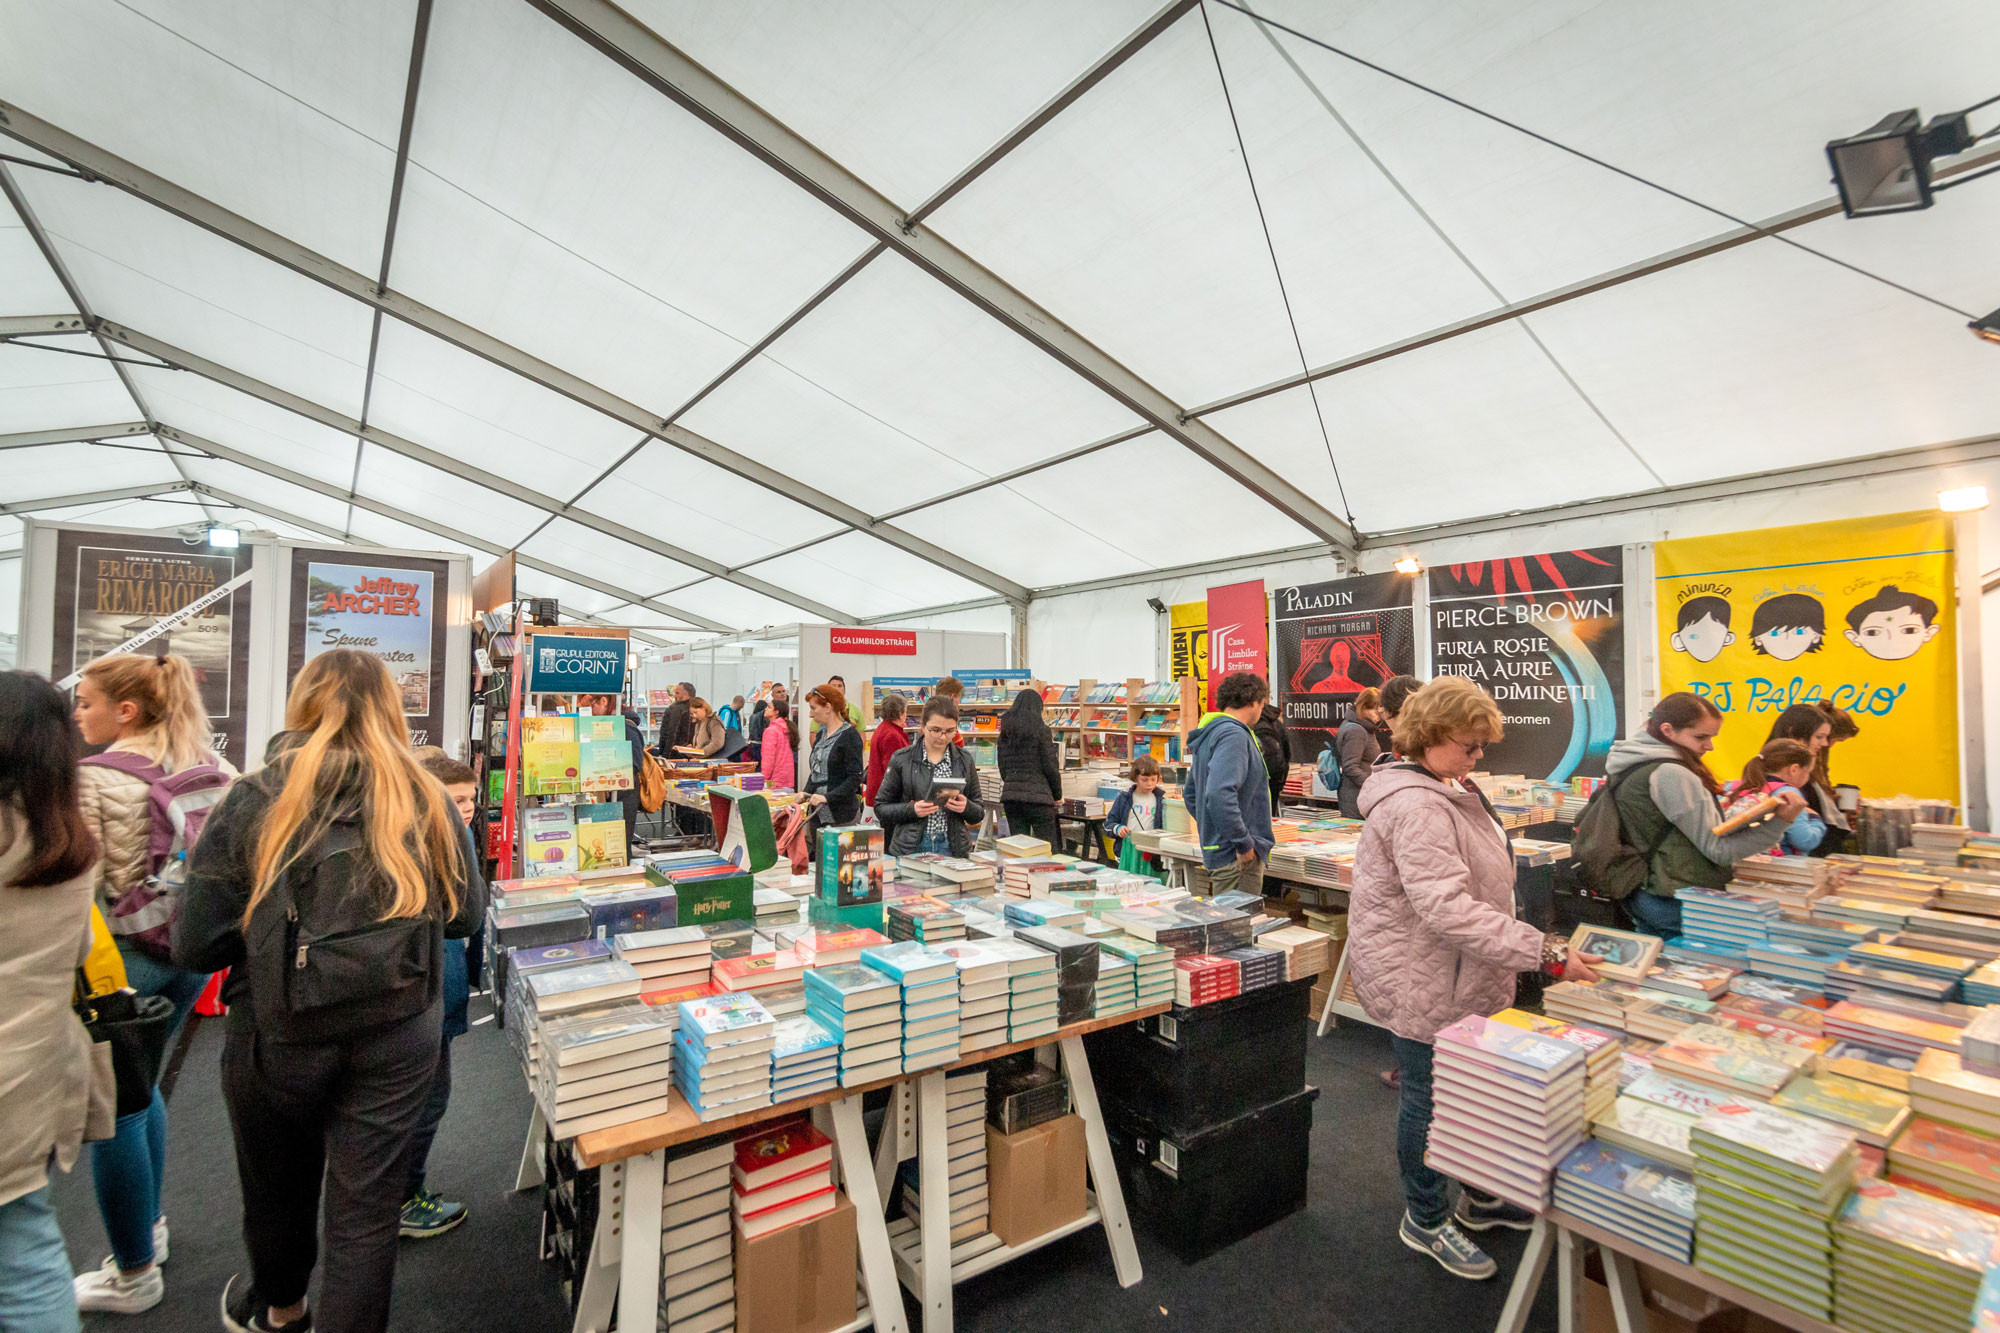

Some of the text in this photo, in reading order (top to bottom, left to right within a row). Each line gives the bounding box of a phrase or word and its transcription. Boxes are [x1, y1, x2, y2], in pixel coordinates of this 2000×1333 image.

[97, 560, 215, 584] ERICH MARIA
[354, 575, 419, 600] Jeffrey
[322, 592, 420, 616] ARCHER
[1281, 586, 1353, 612] PALADIN
[159, 610, 190, 631] limba
[1437, 598, 1613, 629] PIERCE BROWN
[198, 625, 219, 633] 509
[1307, 621, 1371, 636] RICHARD MORGAN
[321, 628, 378, 648] Spune
[832, 636, 851, 644] CASA
[852, 637, 884, 645] LIMBILOR
[1227, 637, 1245, 646] Casa
[555, 649, 619, 660] GRUPUL EDITORIAL
[1173, 632, 1189, 678] HMEN
[1227, 648, 1259, 659] Limbilor
[1437, 640, 1487, 659] FURIA
[555, 659, 619, 674] CORINT
[1438, 660, 1553, 681] FURIA AURIE
[1286, 702, 1328, 719] CARBON
[1501, 715, 1550, 725] enomen
[693, 899, 732, 916] Harry Potter
